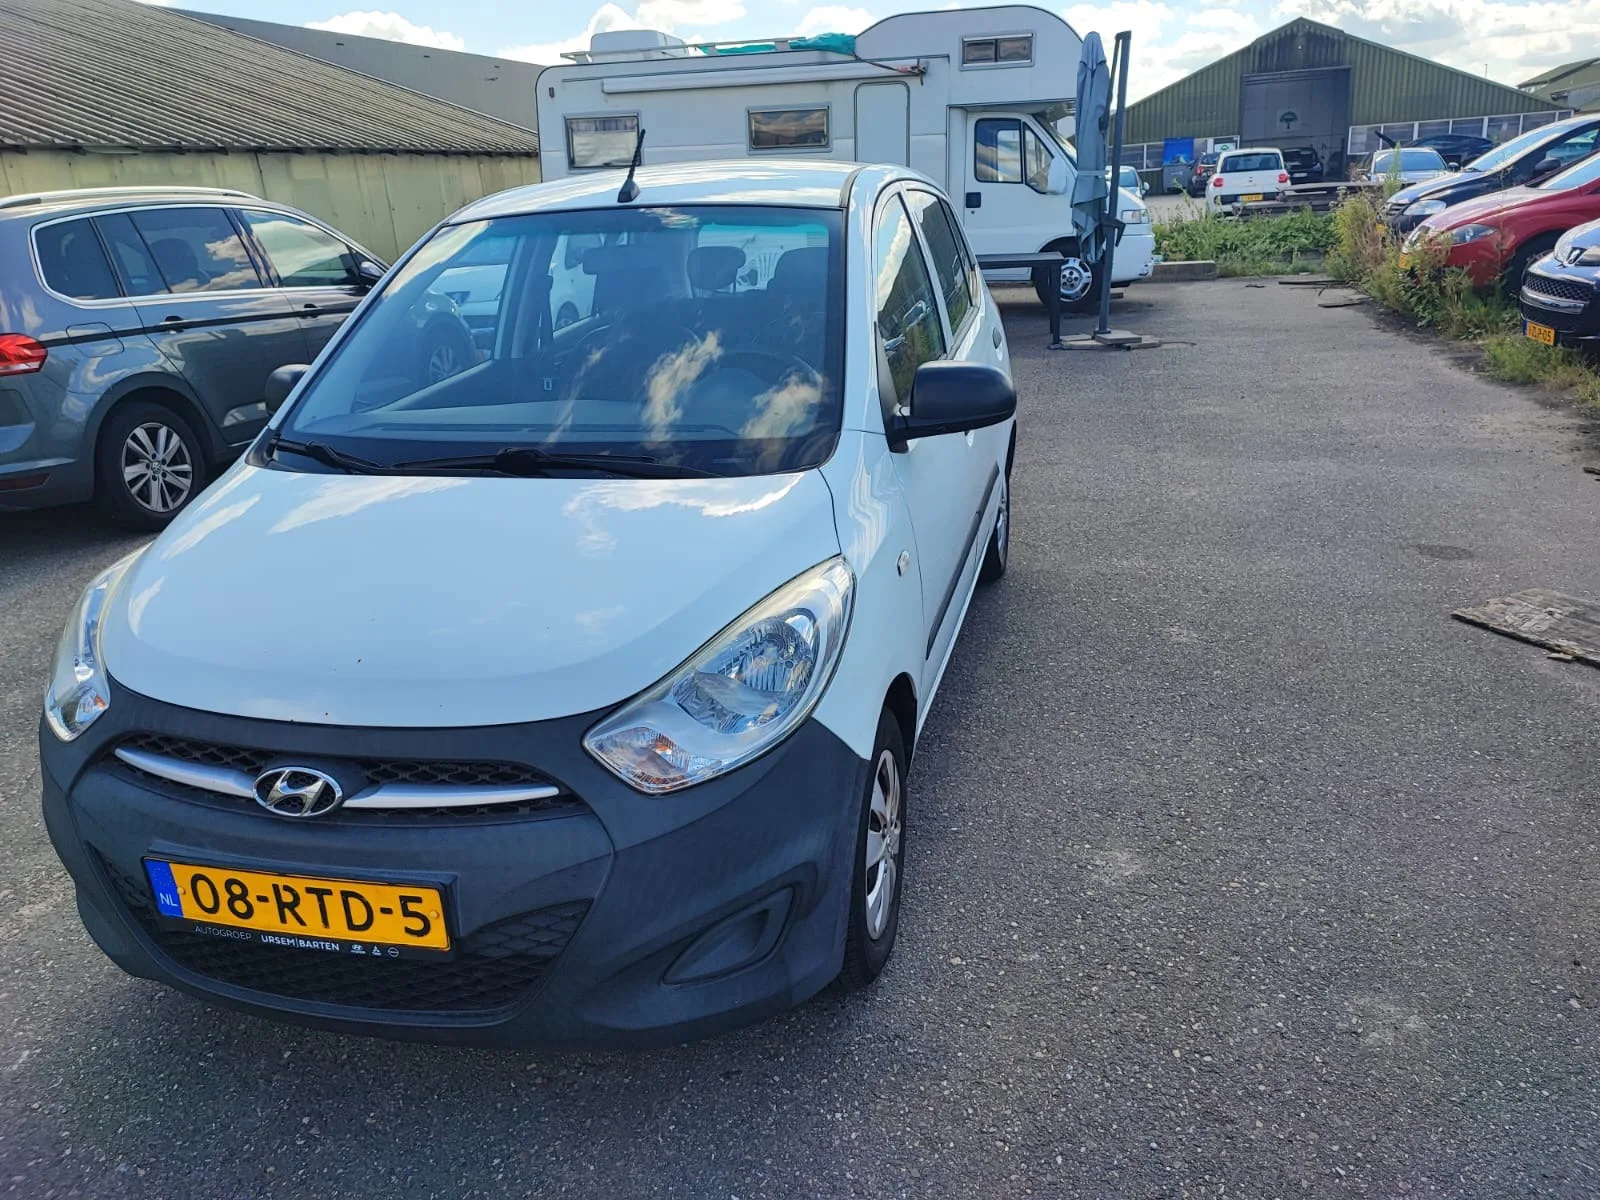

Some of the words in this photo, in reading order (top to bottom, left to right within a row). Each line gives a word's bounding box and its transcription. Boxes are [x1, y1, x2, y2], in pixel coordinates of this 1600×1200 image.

[160, 892, 178, 907] NL
[190, 873, 431, 937] 08-RTD-5
[195, 925, 252, 940] AUTOGROEP
